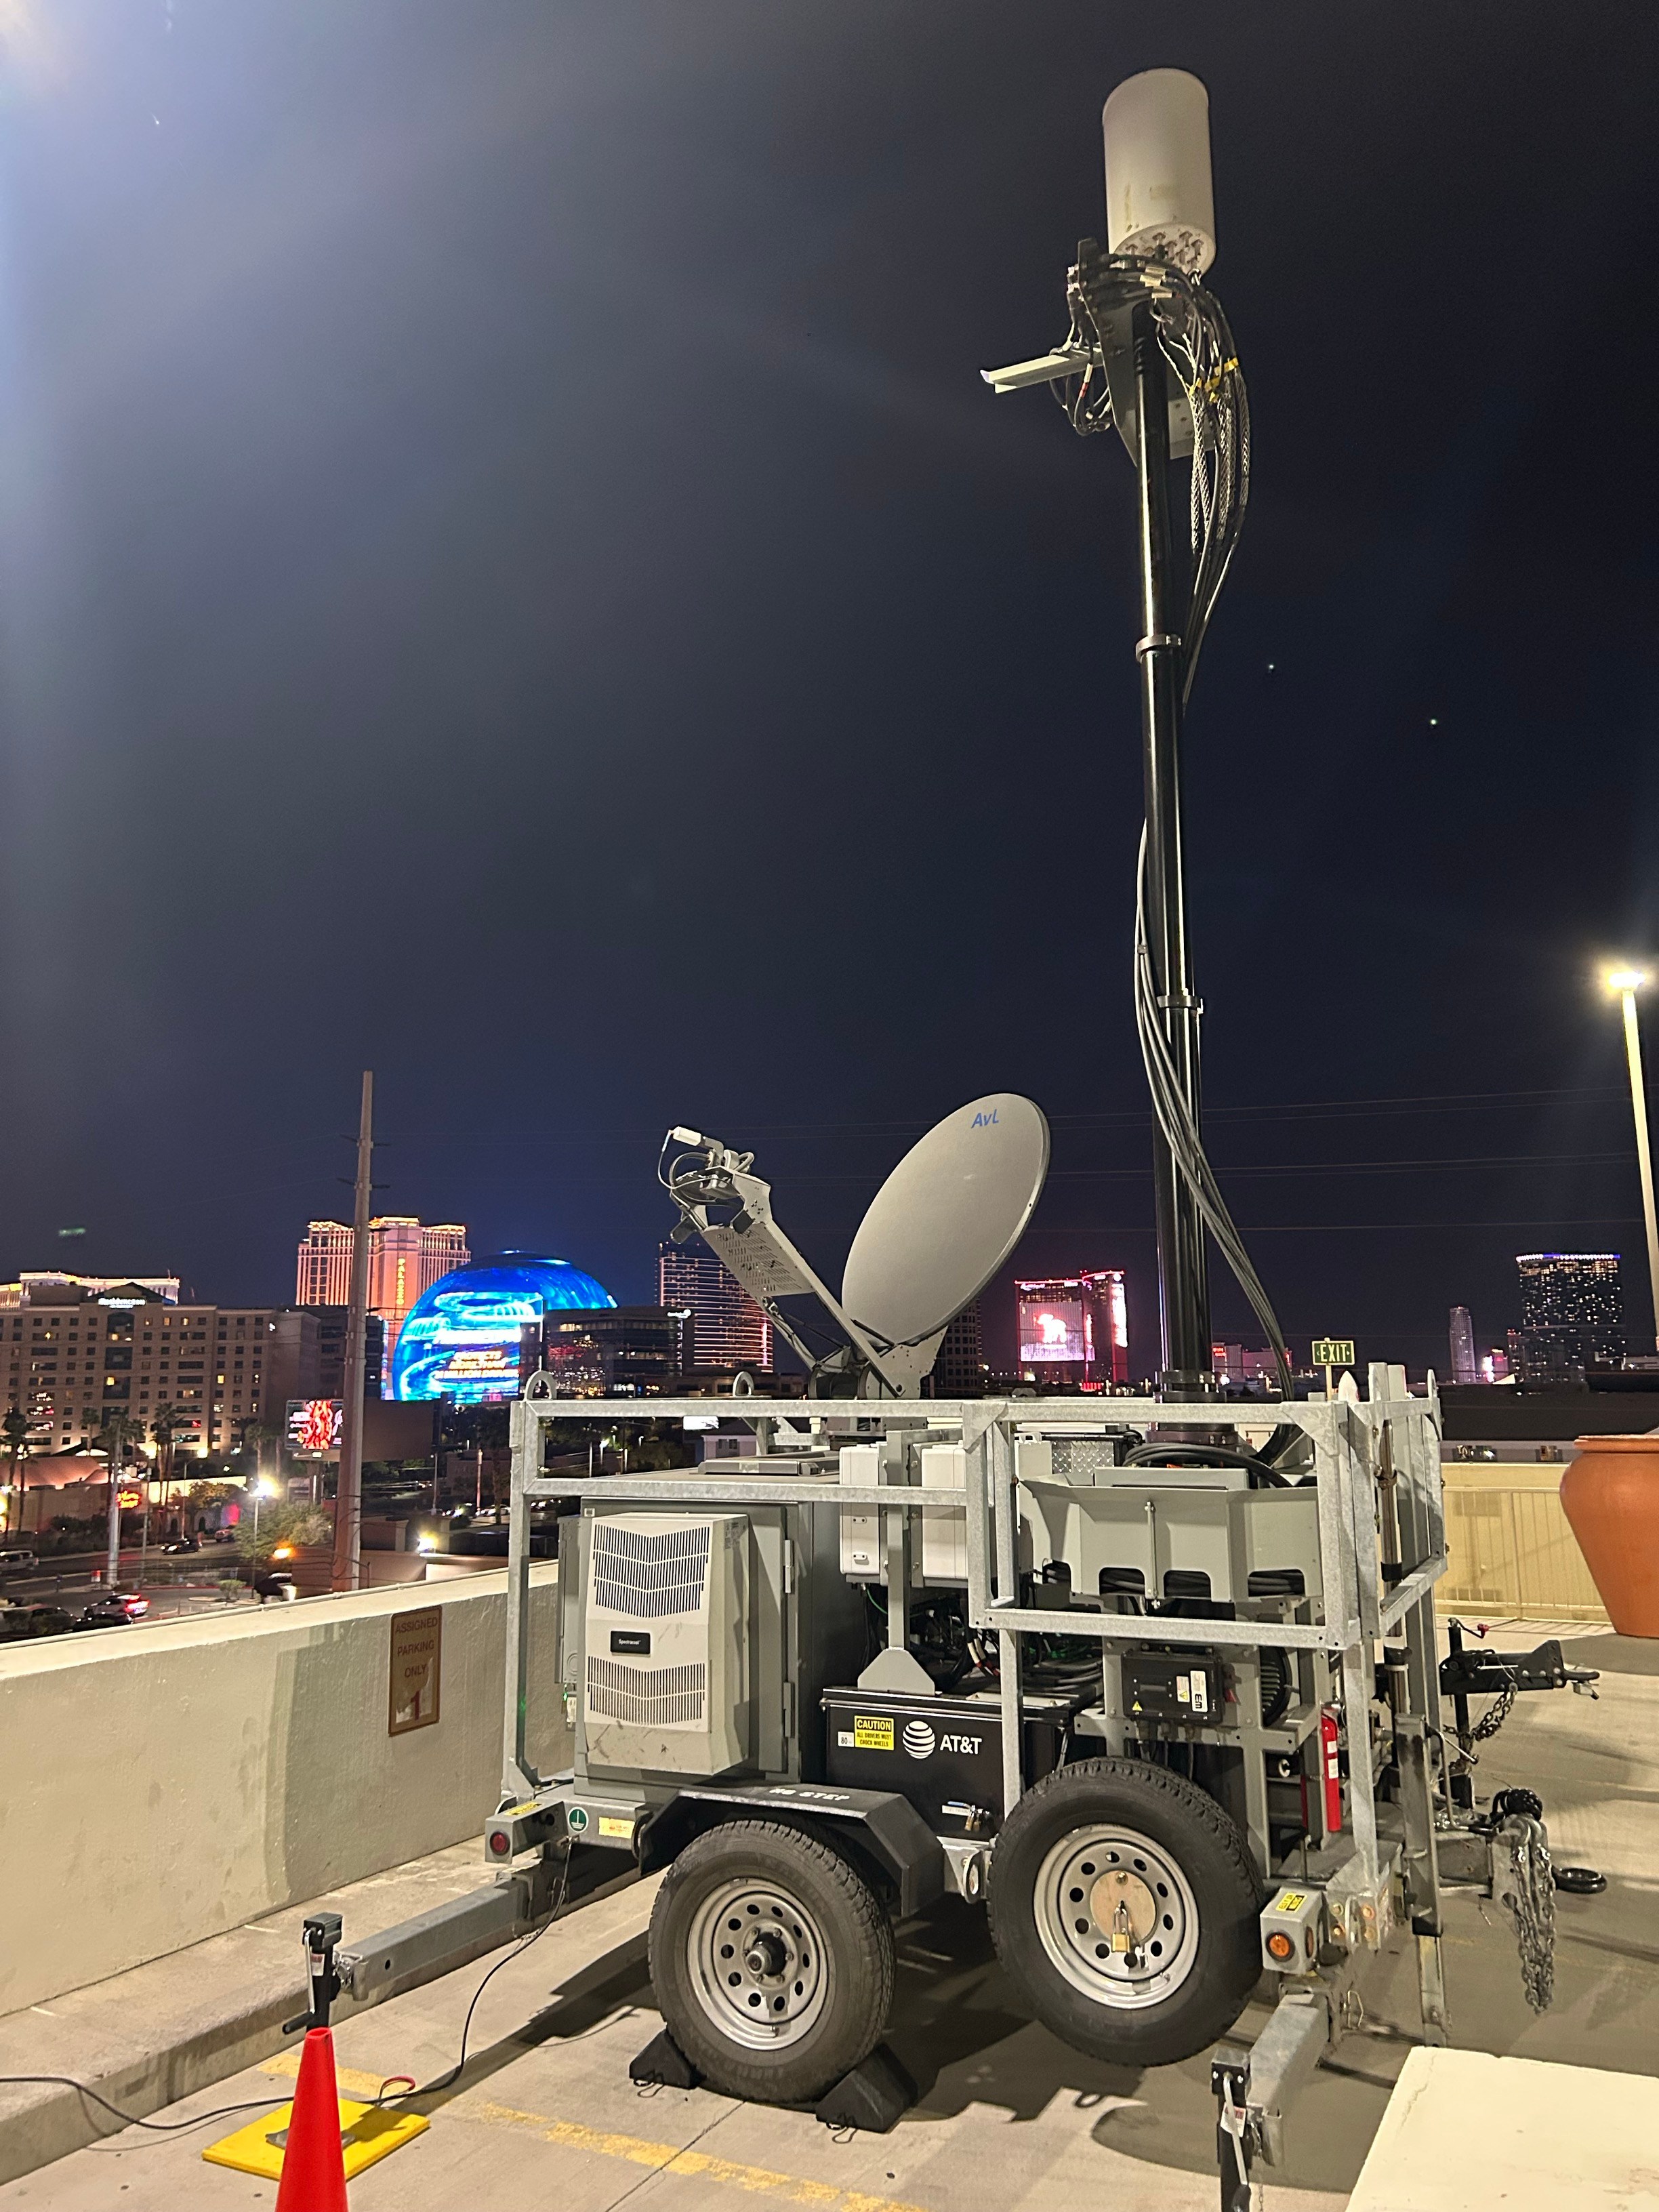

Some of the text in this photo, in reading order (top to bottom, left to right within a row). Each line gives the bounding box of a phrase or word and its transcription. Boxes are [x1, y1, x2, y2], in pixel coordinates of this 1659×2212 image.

[396, 1258, 406, 1305] PALAZZO
[1319, 1344, 1347, 1361] EXIT
[395, 1617, 438, 1634] ASSIGNED
[397, 1640, 434, 1657] PARKING
[405, 1664, 427, 1678] ONLY
[411, 1689, 420, 1721] 1
[857, 1719, 891, 1730] CAUTION
[939, 1734, 982, 1755] AT&T
[799, 1791, 850, 1801] STEP
